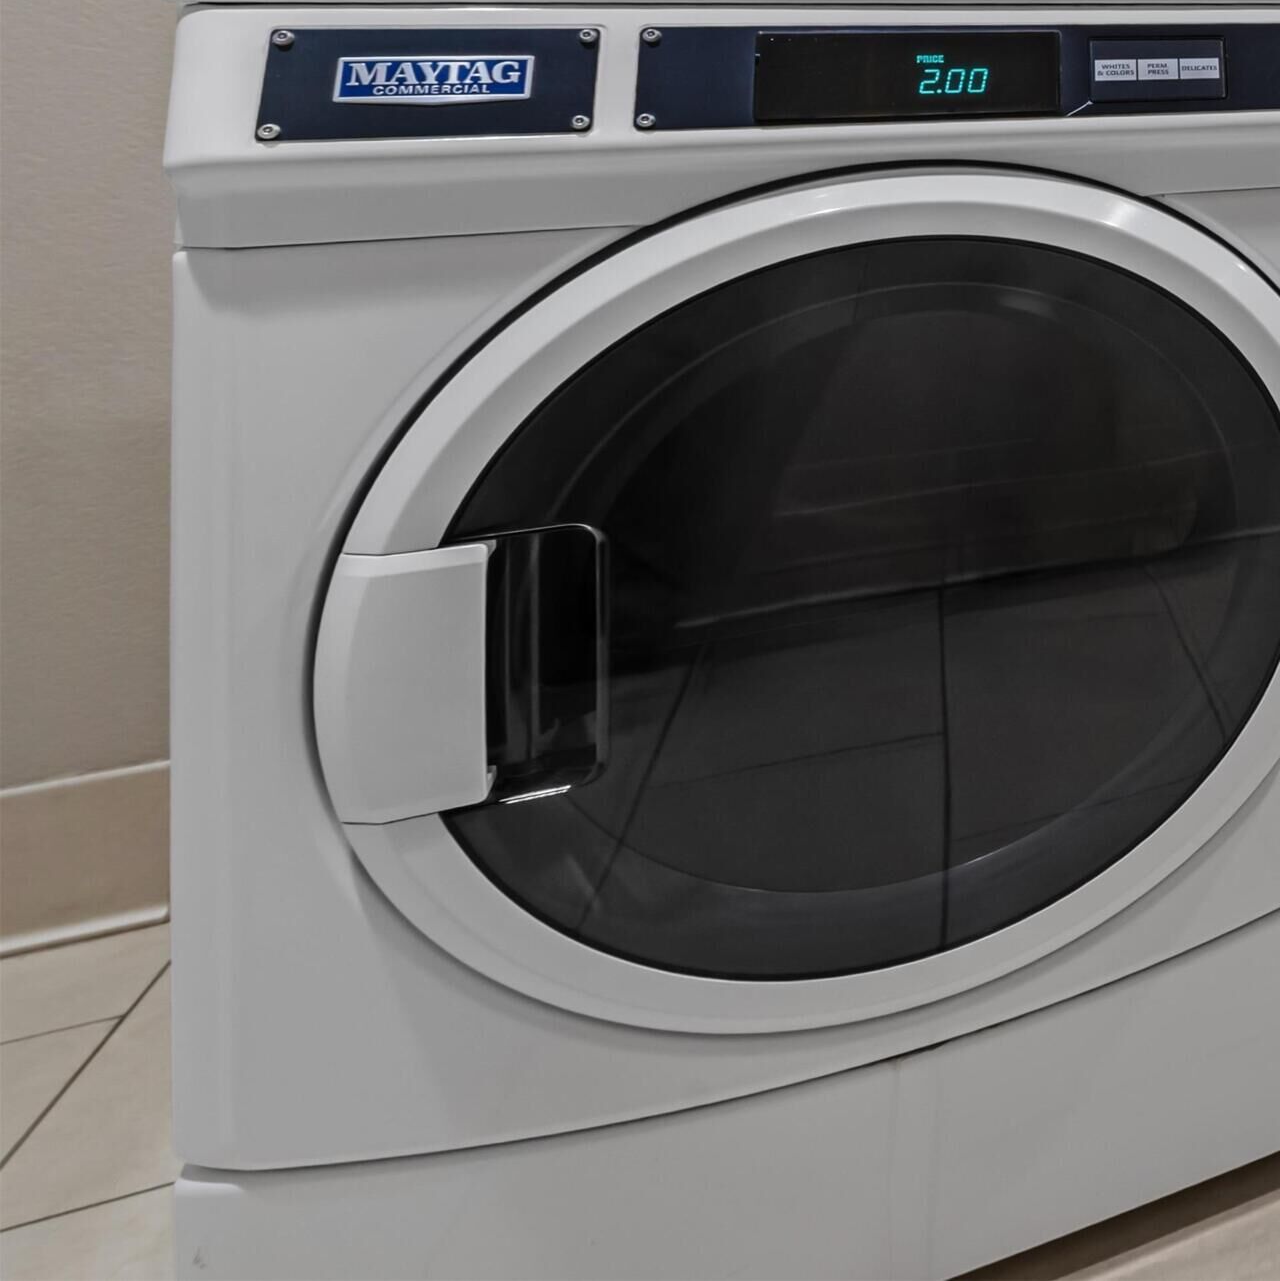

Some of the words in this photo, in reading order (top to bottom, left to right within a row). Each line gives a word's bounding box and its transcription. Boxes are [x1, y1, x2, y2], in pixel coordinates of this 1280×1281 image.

[346, 61, 522, 86] MAYTAG
[919, 68, 989, 94] 2.00
[372, 84, 491, 96] COMMERCIAL
